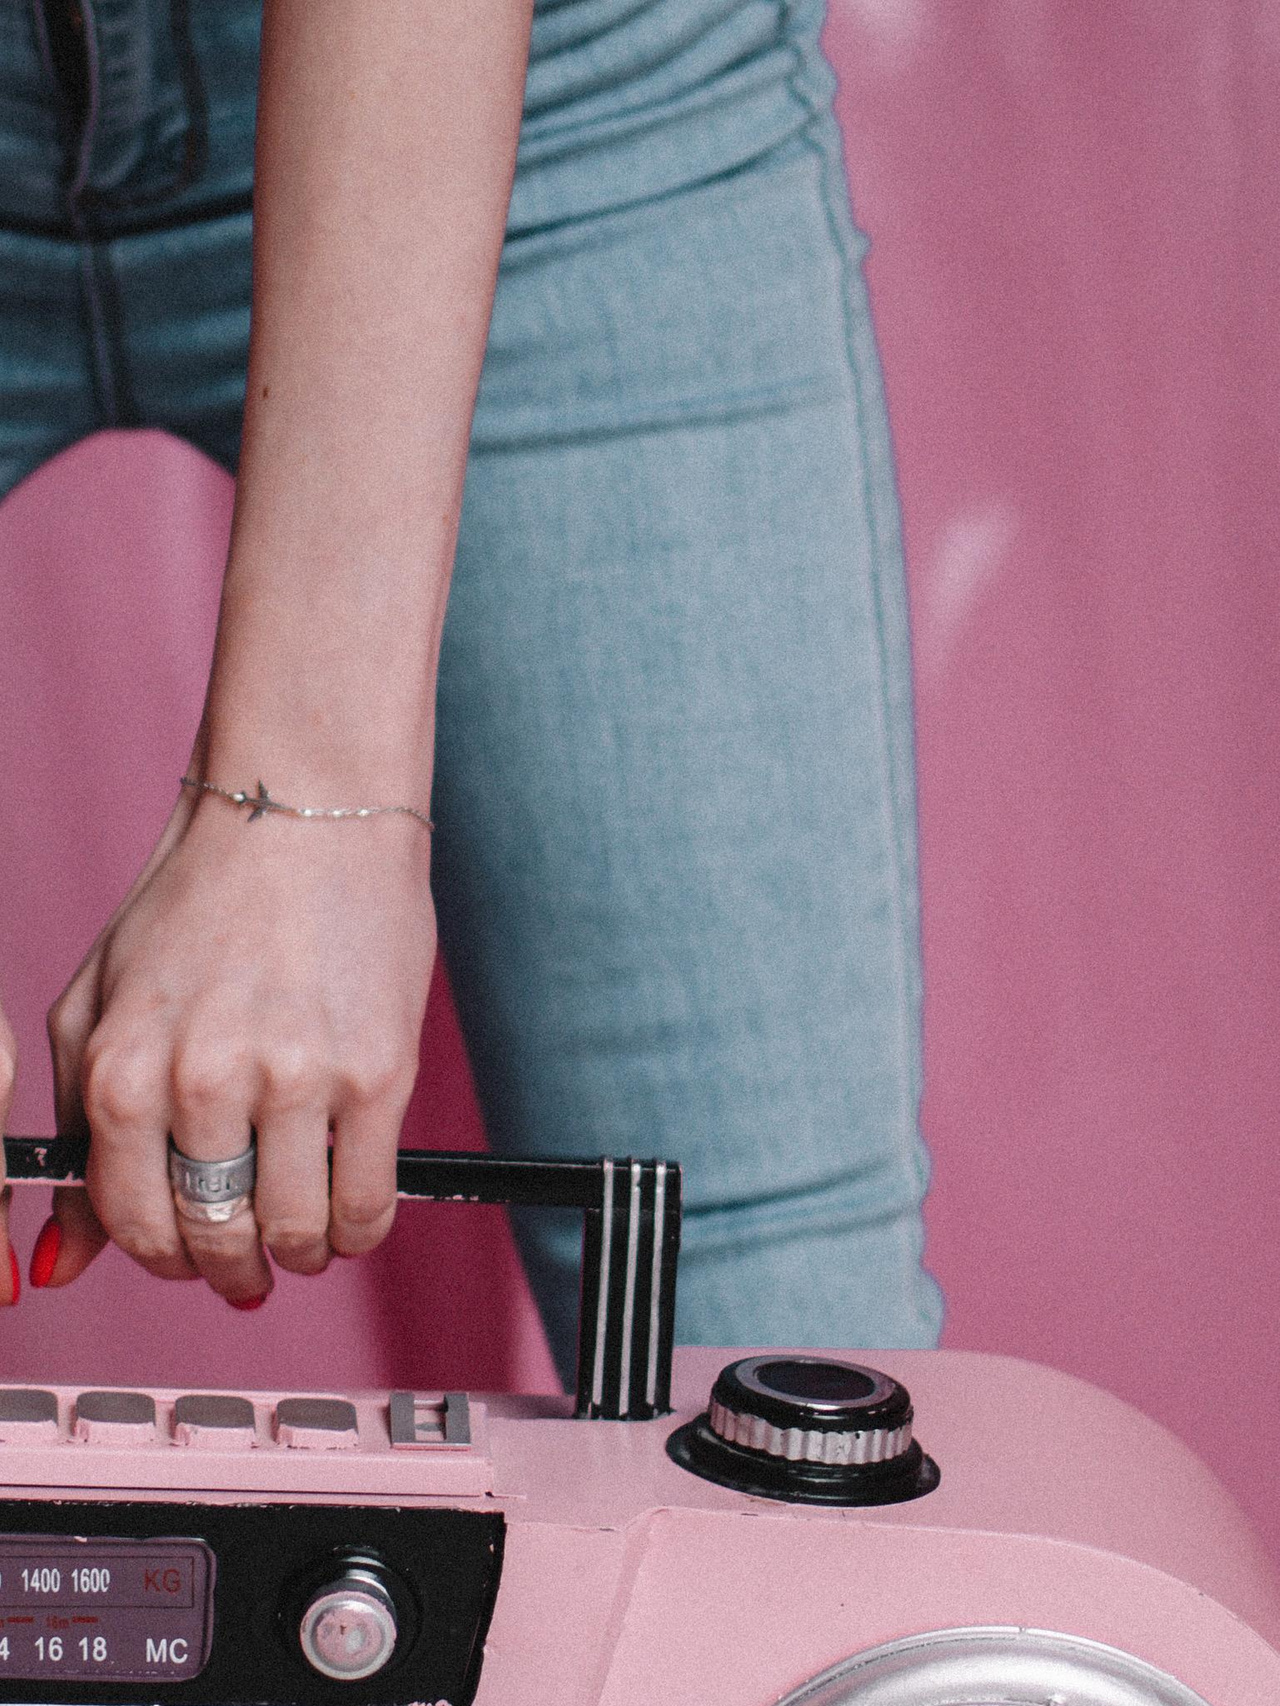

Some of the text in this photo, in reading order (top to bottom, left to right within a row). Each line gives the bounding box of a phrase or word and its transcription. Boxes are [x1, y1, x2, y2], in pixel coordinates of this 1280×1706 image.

[21, 1567, 61, 1593] 1400
[71, 1567, 111, 1593] 1600
[143, 1568, 181, 1593] KG
[34, 1636, 64, 1662] 16
[78, 1636, 108, 1662] 18
[146, 1638, 188, 1664] MC
